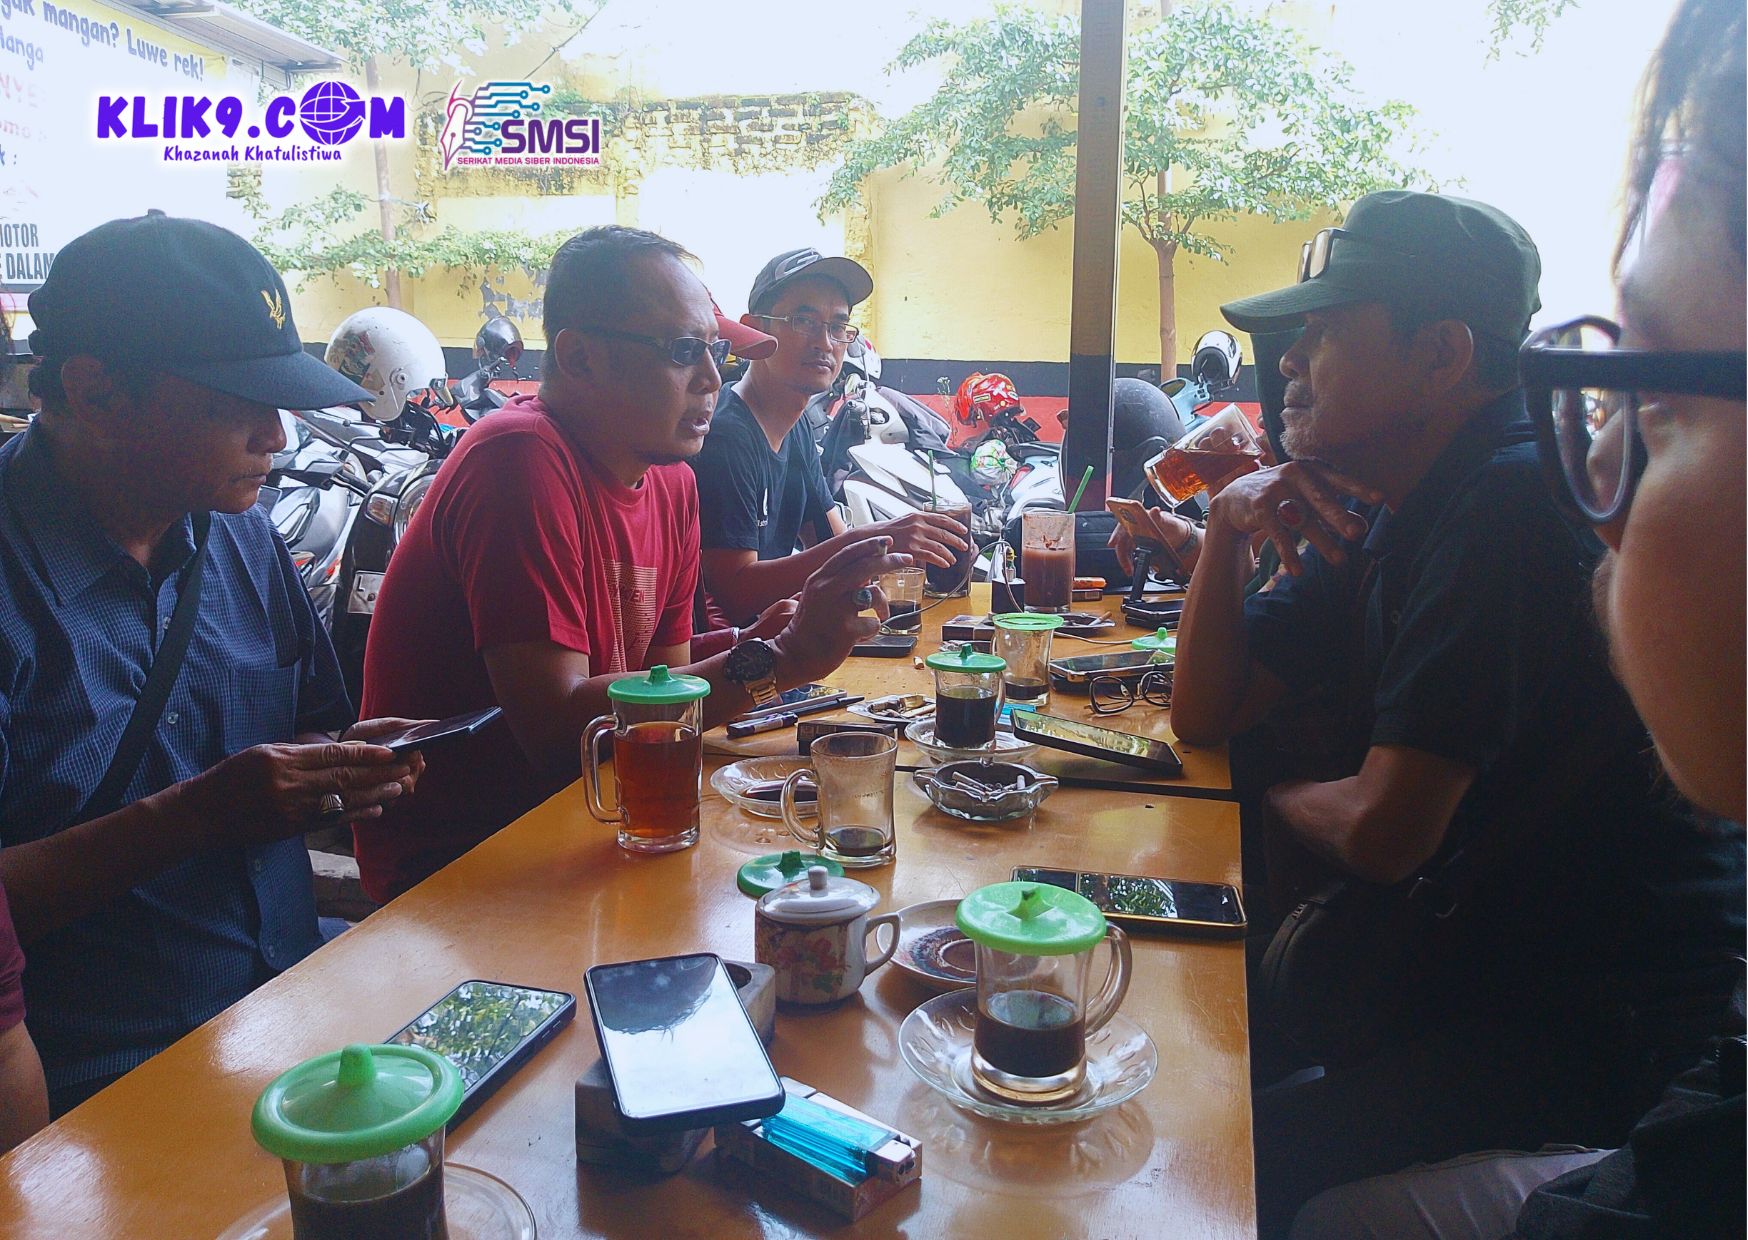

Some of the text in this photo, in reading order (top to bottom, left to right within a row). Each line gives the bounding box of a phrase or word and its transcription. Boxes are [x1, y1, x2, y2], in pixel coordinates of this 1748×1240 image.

[43, 1, 119, 47] mangan?
[127, 28, 168, 67] Luwe
[174, 53, 203, 82] rek!
